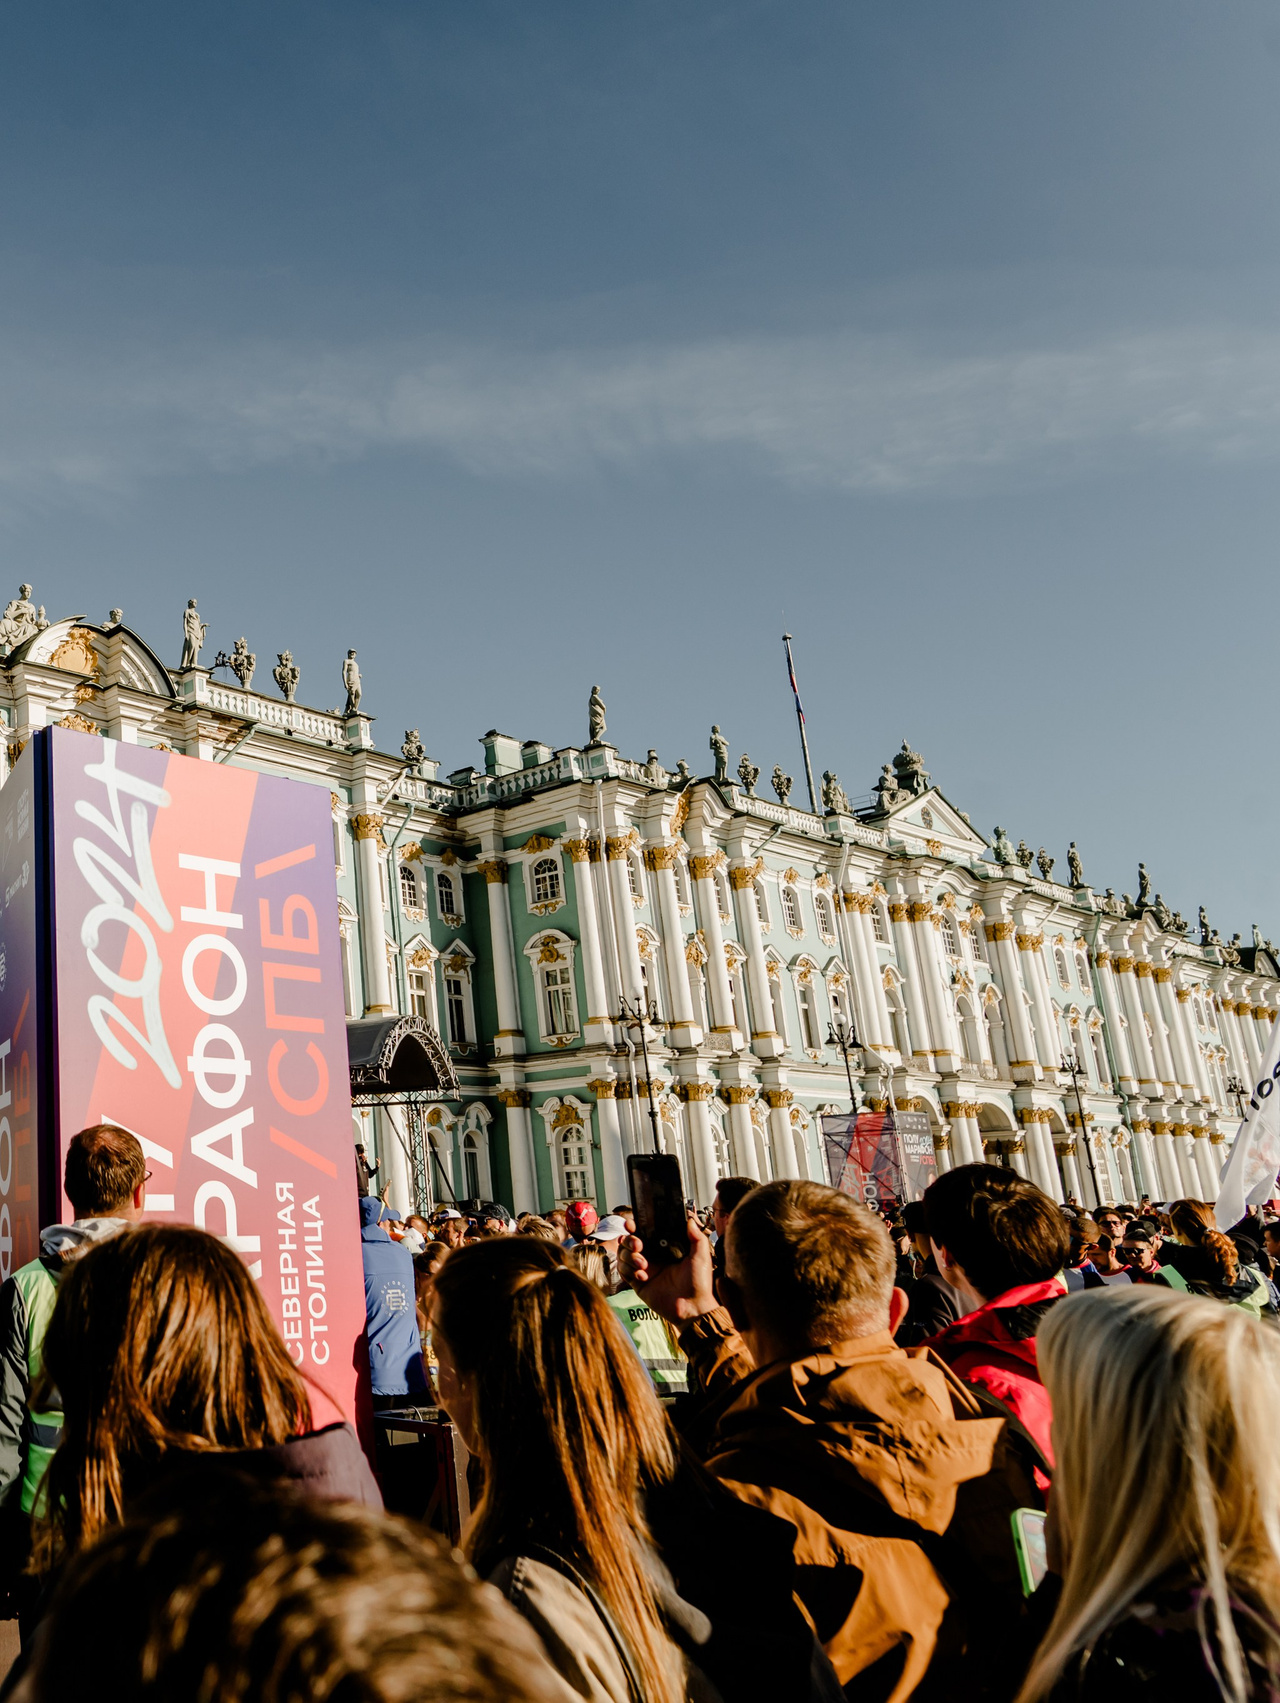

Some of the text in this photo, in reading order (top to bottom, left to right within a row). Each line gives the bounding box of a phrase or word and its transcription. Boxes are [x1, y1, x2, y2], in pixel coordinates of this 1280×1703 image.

[73, 738, 182, 1089] 2024
[178, 853, 263, 1281] РАФОН
[903, 1134, 919, 1144] ПОЛУ
[904, 1143, 933, 1155] МАРАФОН
[275, 1182, 304, 1367] СЕВЕРНАЯ
[302, 1195, 330, 1365] СТОЛИЦА
[627, 1308, 659, 1322] ВОЛО
